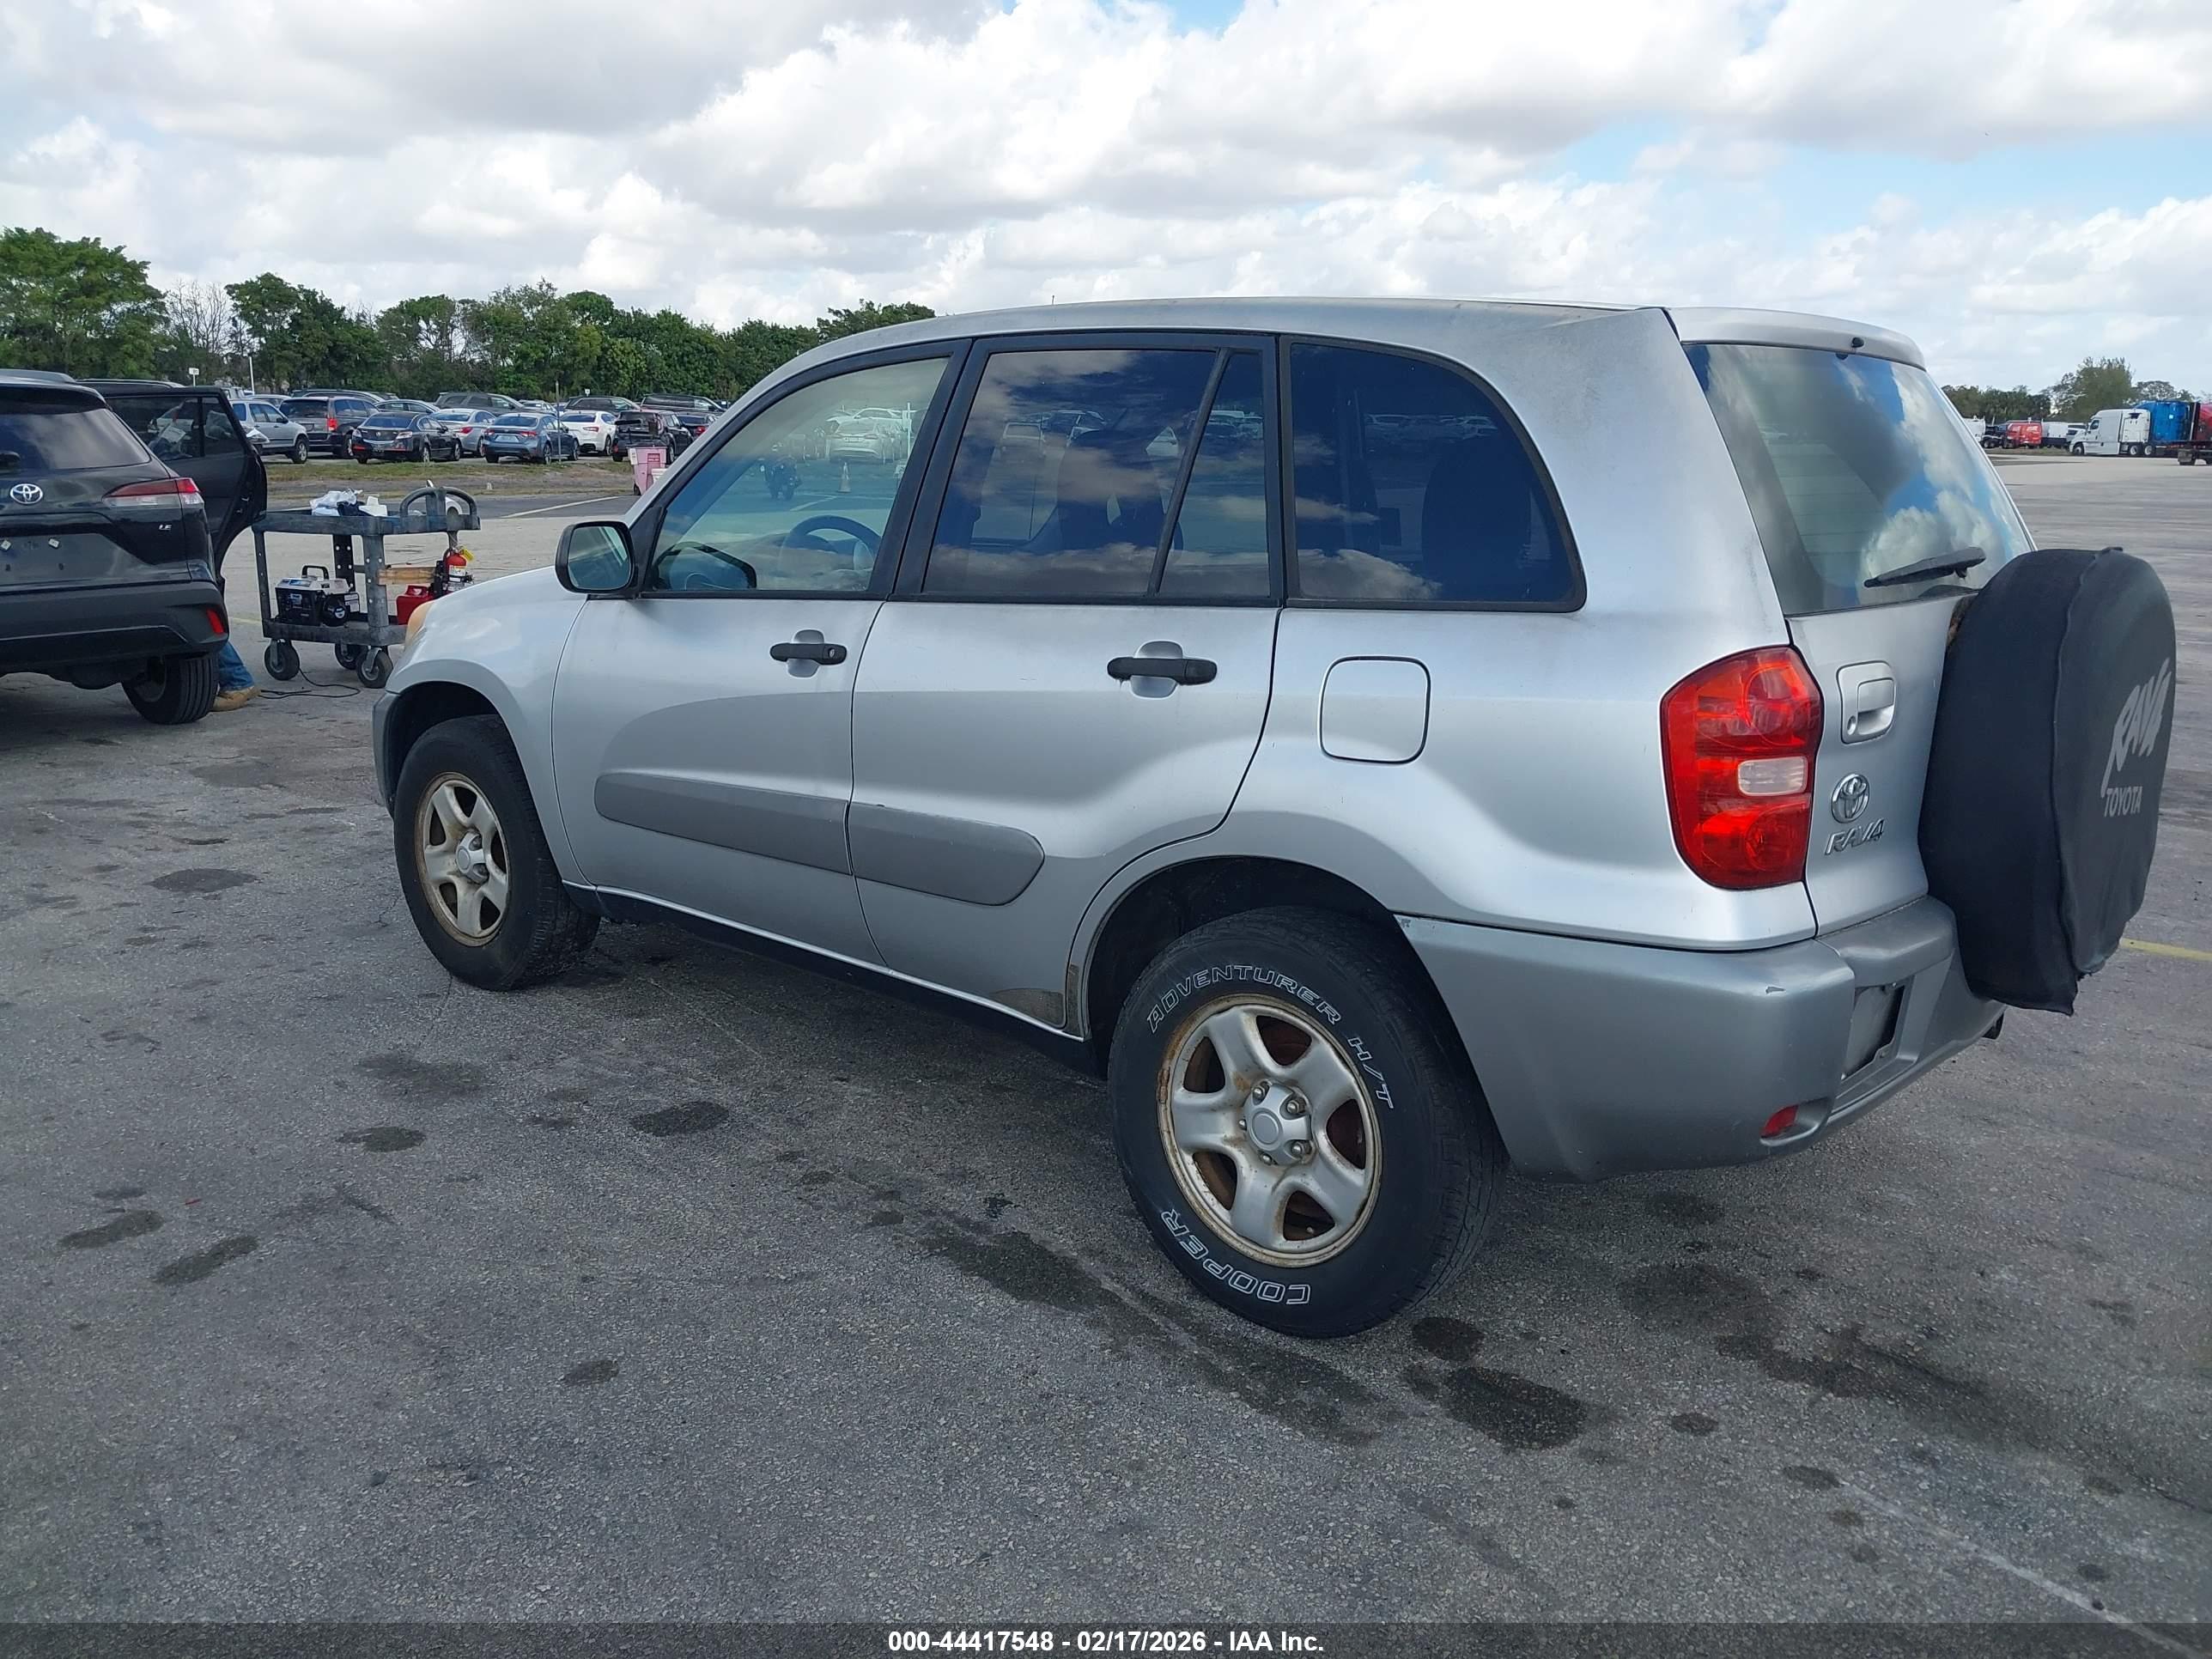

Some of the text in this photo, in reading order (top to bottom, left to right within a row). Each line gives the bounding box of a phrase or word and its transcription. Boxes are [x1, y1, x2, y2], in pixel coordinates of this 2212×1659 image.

[2104, 786, 2143, 817] TOYOTA
[1824, 817, 1885, 855] RAV4
[1146, 964, 1395, 1110] ADVENTURER H/T
[1160, 1208, 1313, 1306] COOPER
